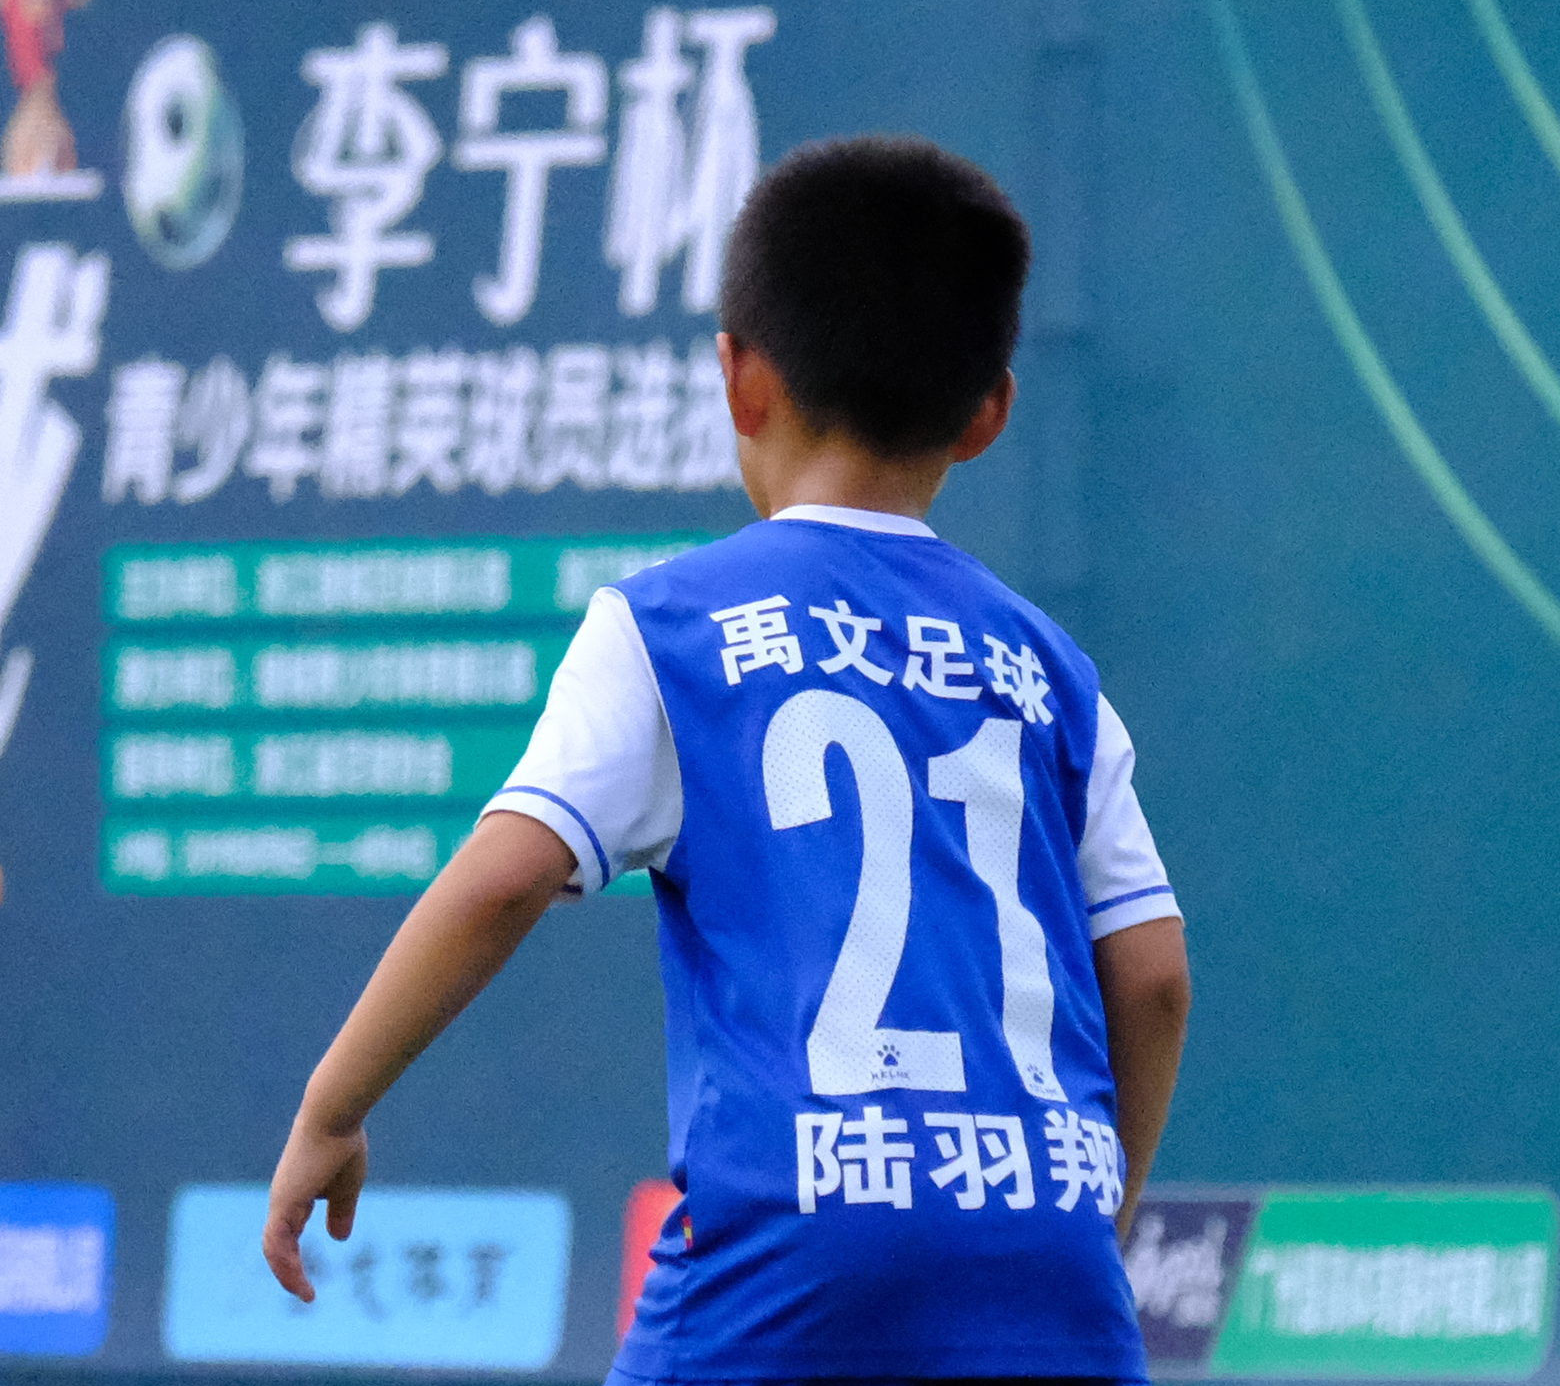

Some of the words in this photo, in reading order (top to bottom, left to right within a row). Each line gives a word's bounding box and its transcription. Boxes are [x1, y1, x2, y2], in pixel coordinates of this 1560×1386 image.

[282, 6, 777, 333] 李宁杯
[710, 594, 1054, 725] 禹文足球
[762, 689, 1068, 1103] 21
[795, 1106, 1123, 1214] 陆羽翔
